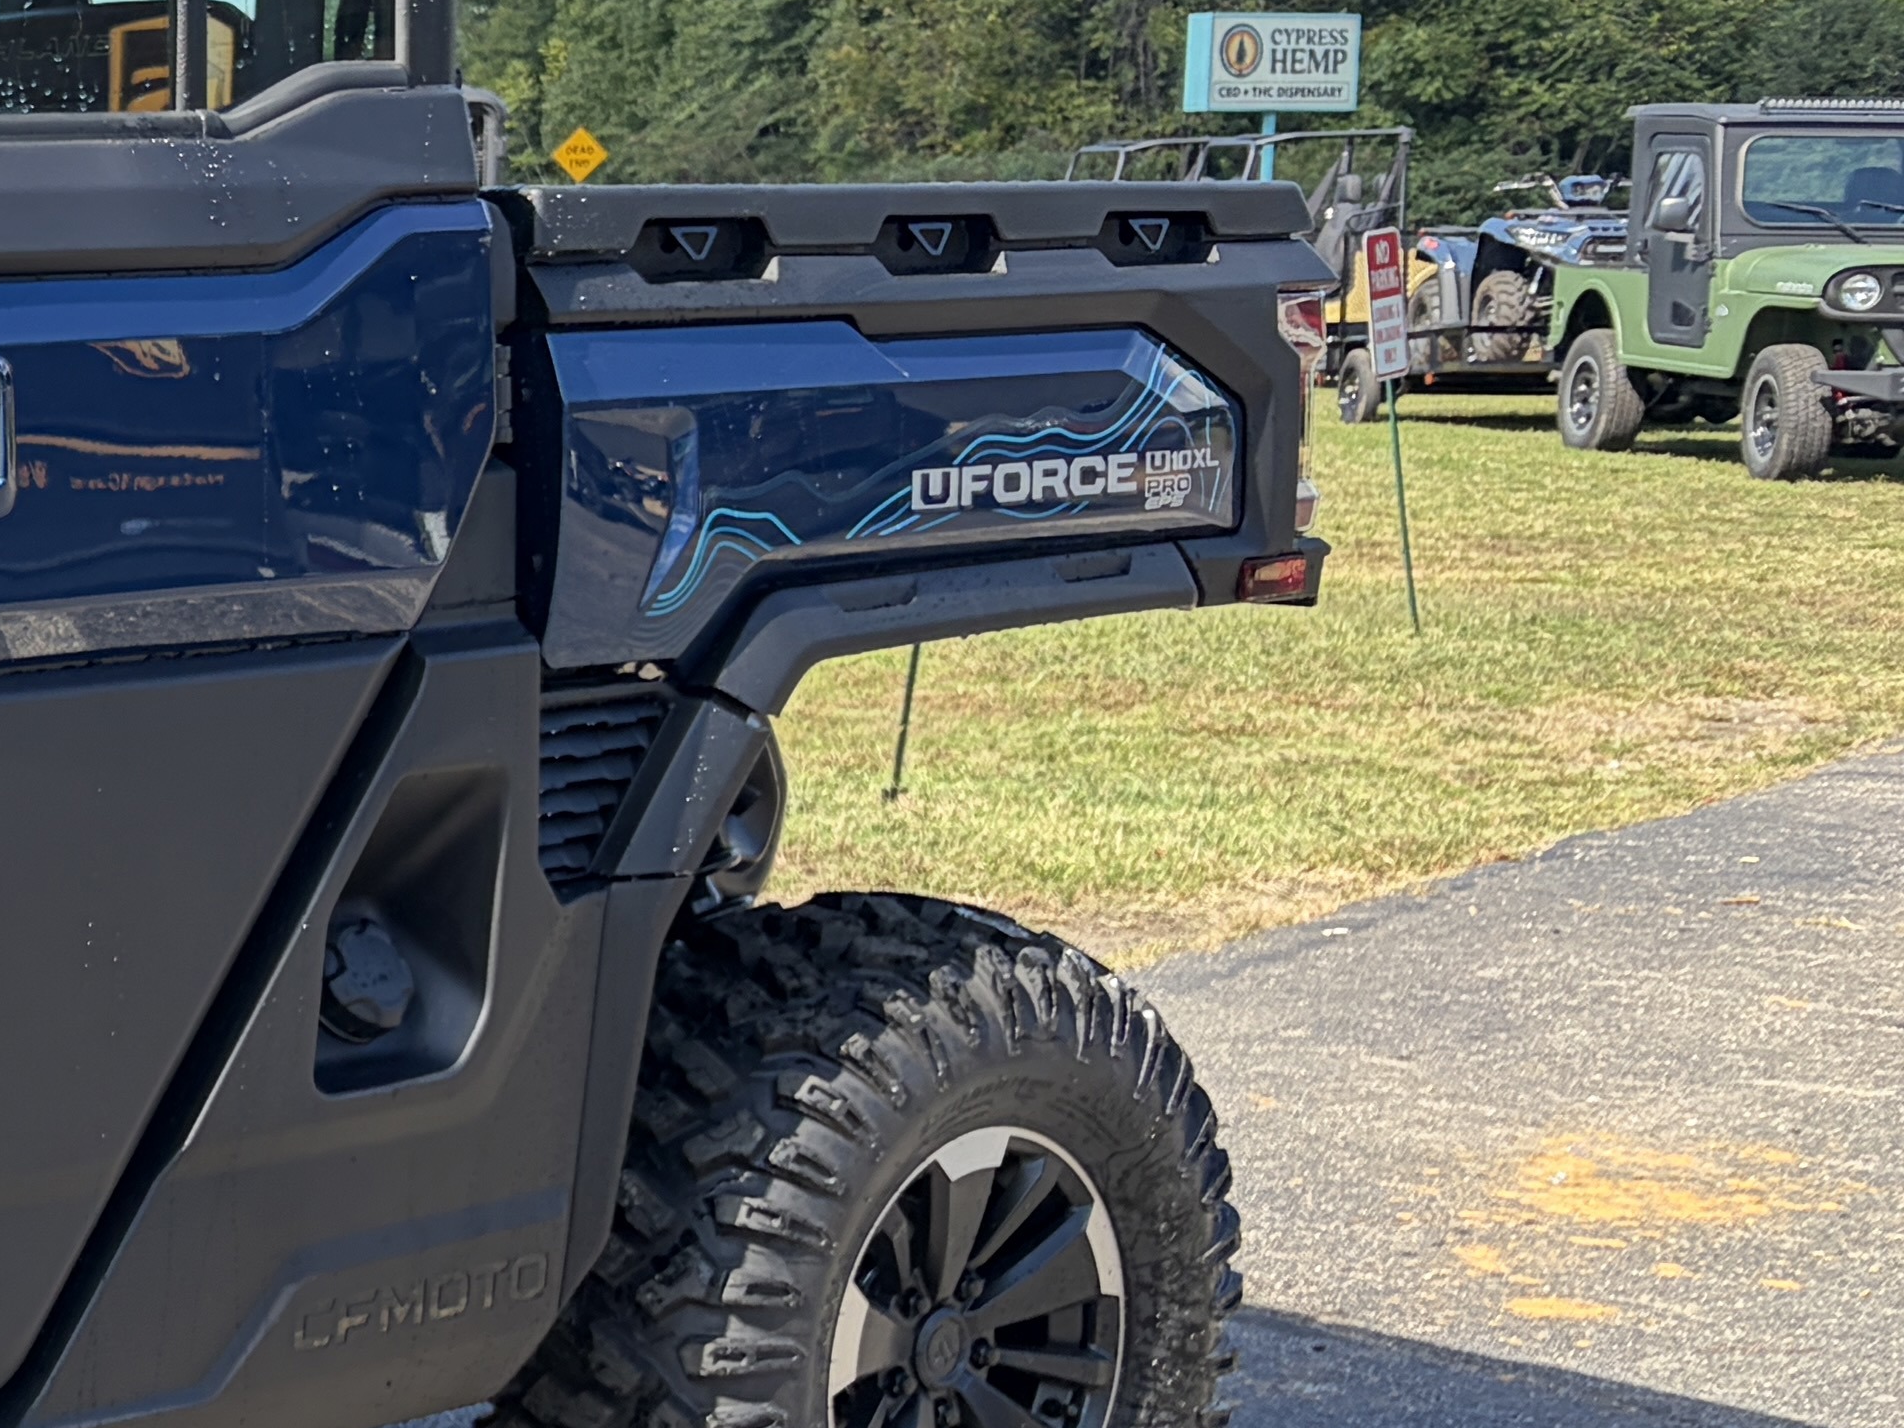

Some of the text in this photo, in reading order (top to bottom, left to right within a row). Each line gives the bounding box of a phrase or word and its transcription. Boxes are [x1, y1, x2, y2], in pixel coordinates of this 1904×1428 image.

[1270, 28, 1349, 46] CYPRESS
[1270, 48, 1348, 74] HEMP
[1218, 86, 1343, 98] CBD THC DISPENSARY
[565, 145, 594, 156] DEAD
[912, 452, 1138, 511] UFORCE
[1145, 473, 1192, 498] PRO
[294, 1251, 550, 1352] CFMOTO
